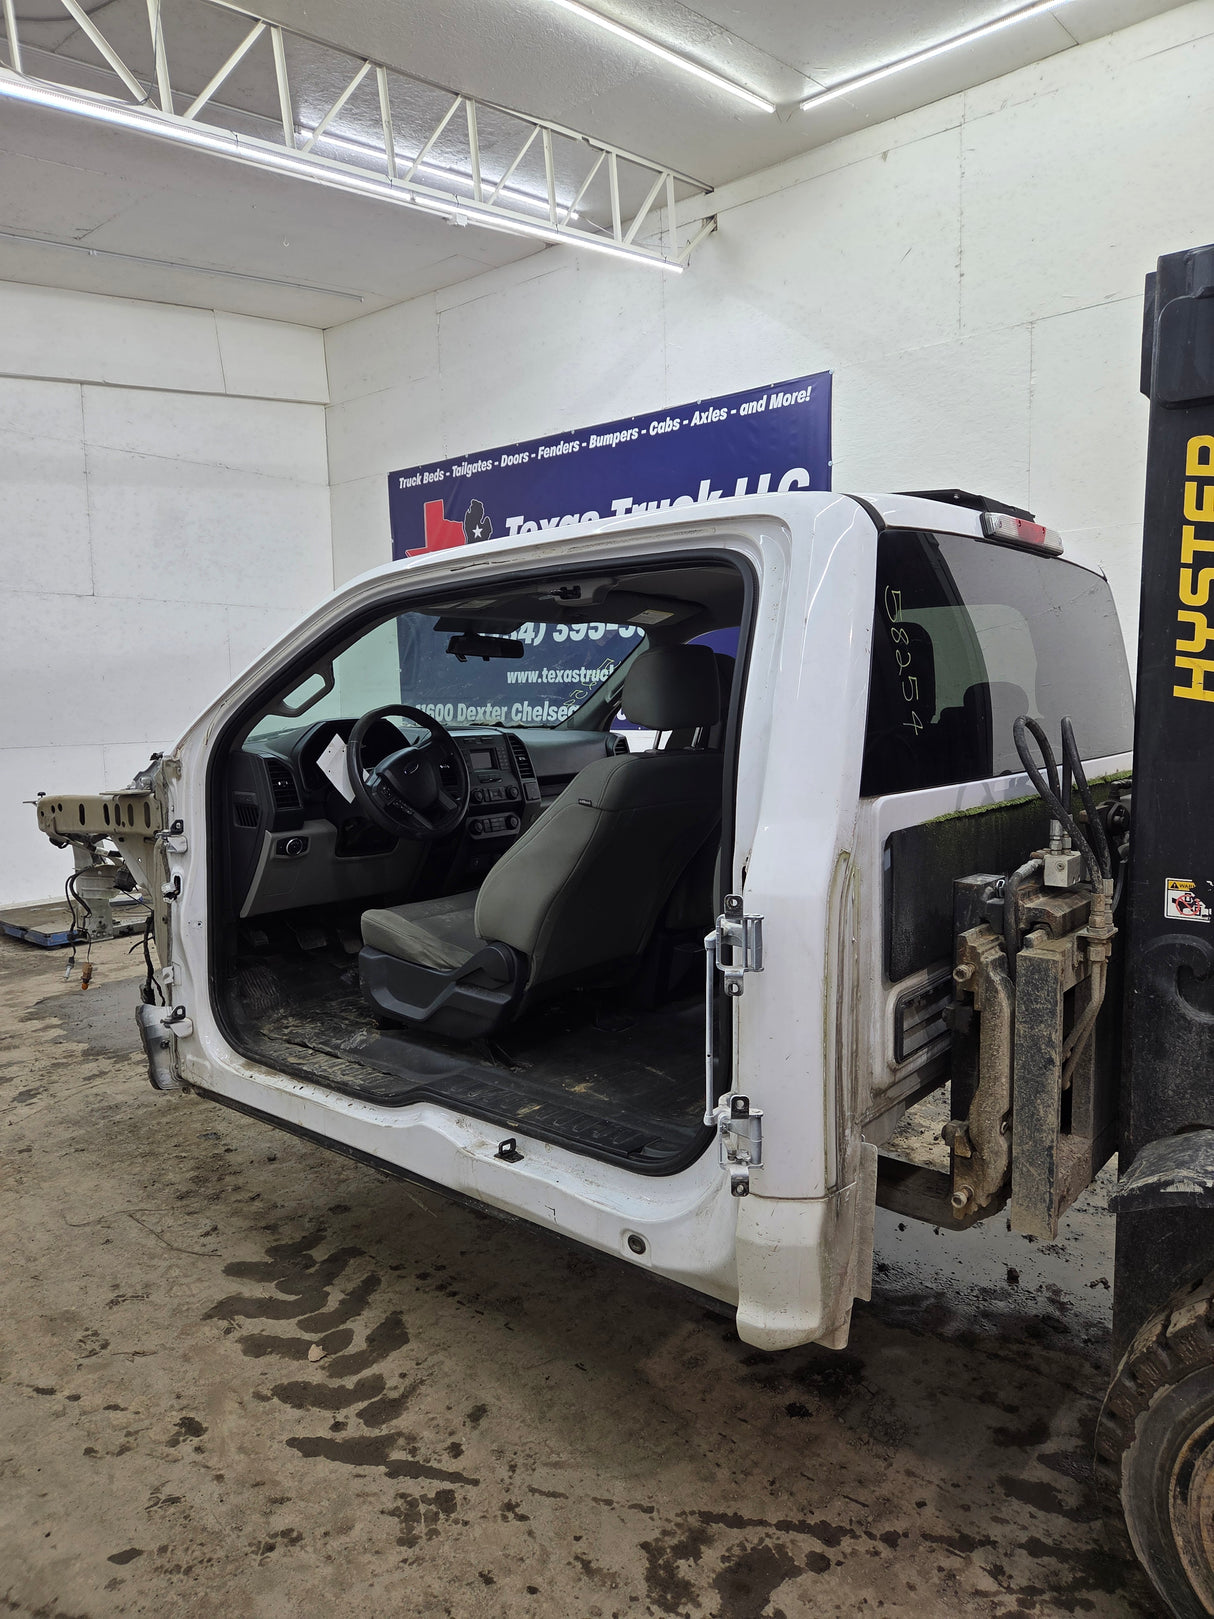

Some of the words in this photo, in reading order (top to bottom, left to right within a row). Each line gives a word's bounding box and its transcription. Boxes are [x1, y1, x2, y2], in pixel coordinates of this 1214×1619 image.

[399, 473, 422, 489] Truck
[423, 469, 445, 484] Beds
[452, 459, 493, 478] Tailgates
[500, 452, 530, 468] Doors
[538, 440, 580, 460] Fenders
[589, 427, 639, 448] Bumpers
[649, 416, 680, 436] Cabs
[691, 406, 728, 427] Axles
[739, 397, 767, 416] and
[769, 386, 812, 410] More!
[884, 585, 924, 736] 58254
[415, 703, 454, 722] 600
[457, 703, 507, 722] Dexter
